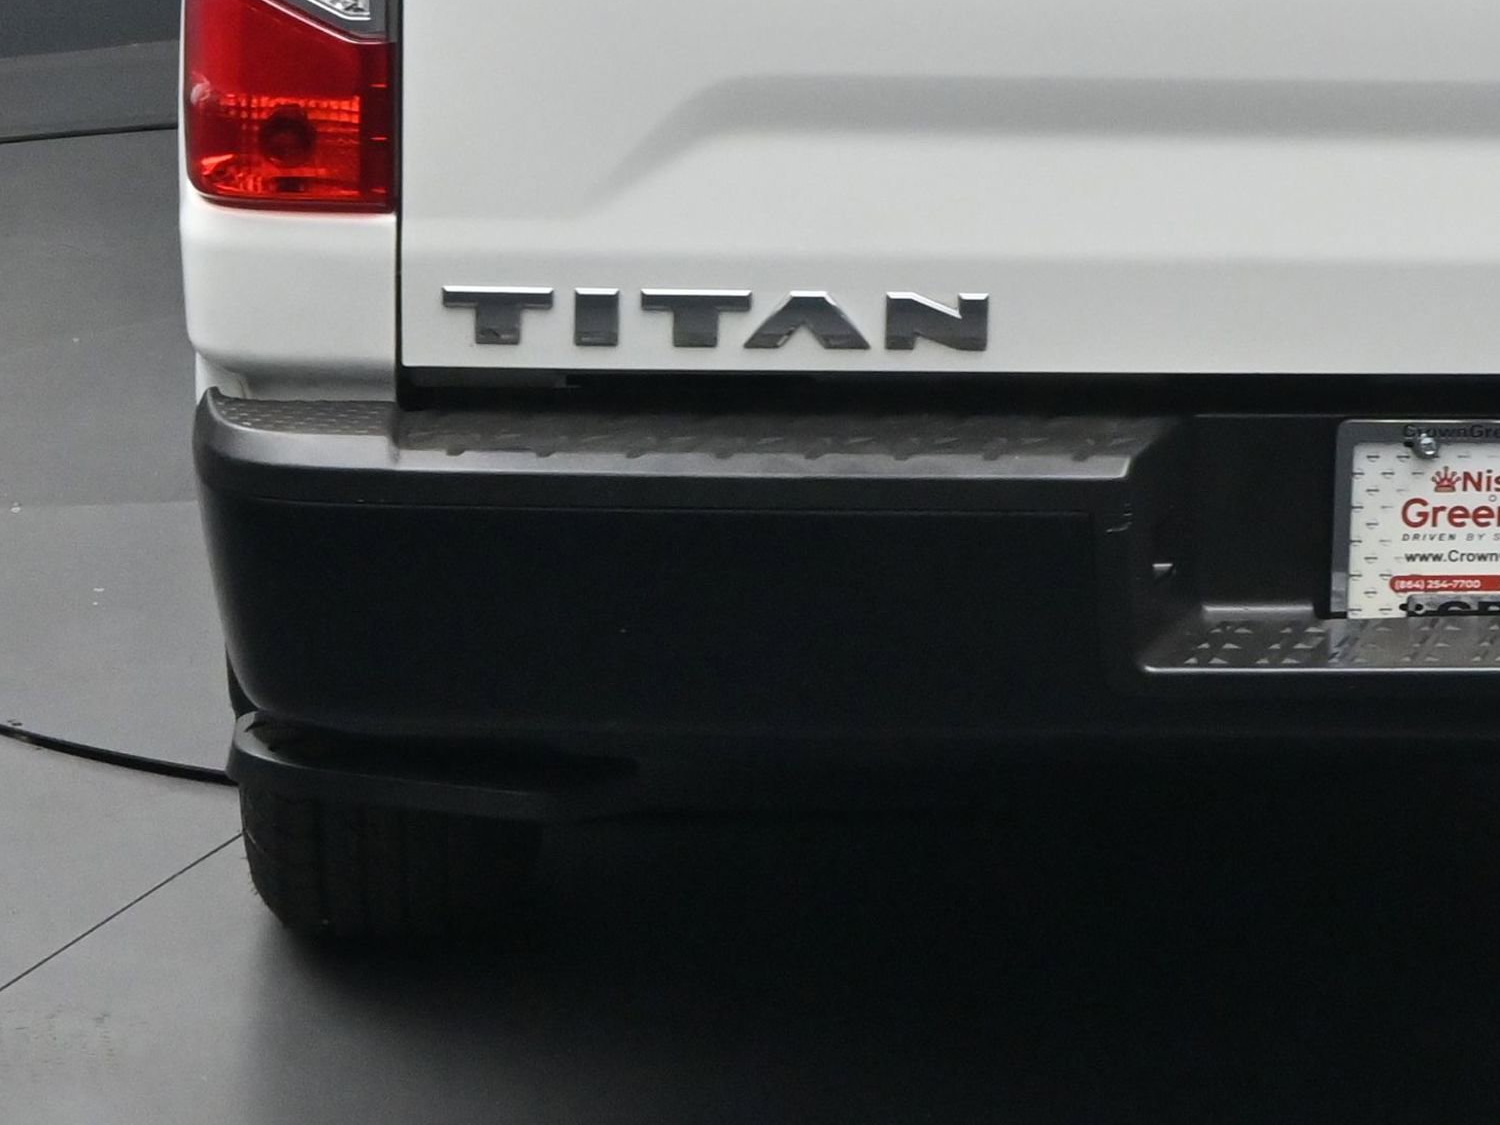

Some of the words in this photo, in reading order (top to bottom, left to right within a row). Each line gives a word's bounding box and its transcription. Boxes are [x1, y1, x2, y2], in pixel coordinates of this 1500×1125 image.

[441, 285, 989, 351] TITAN
[1402, 533, 1456, 541] DRIVEN
[1466, 533, 1485, 541] BY
